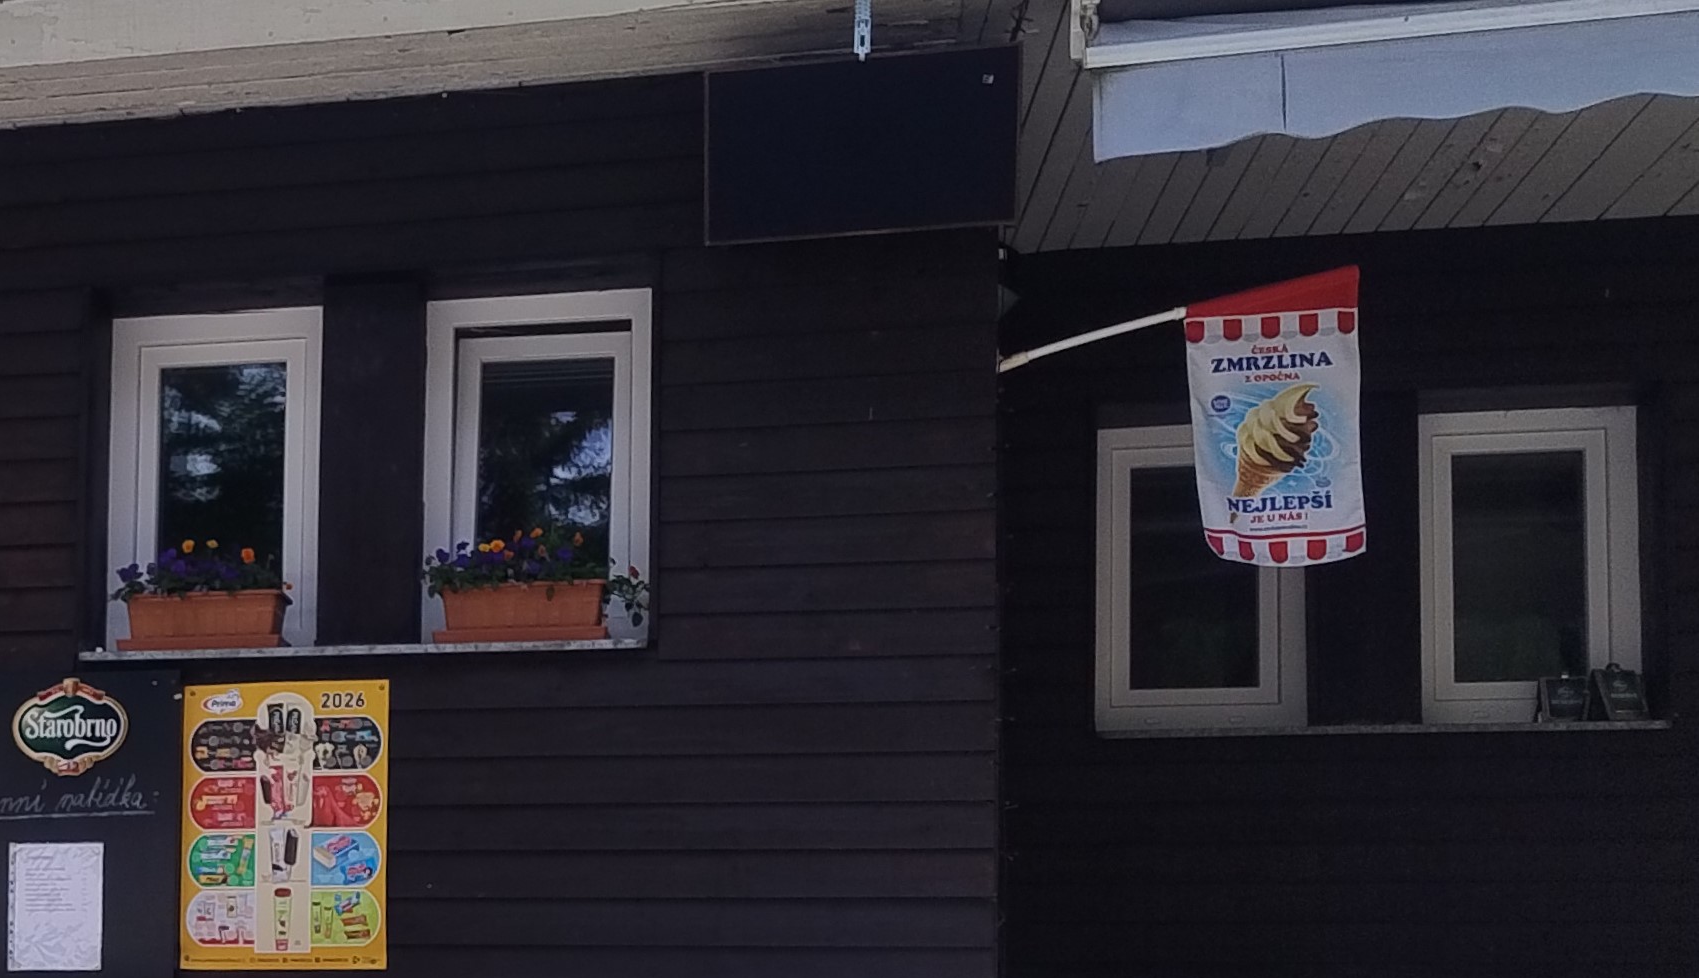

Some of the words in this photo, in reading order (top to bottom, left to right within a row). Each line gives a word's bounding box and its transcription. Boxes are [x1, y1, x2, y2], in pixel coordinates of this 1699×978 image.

[1251, 343, 1289, 355] ČESKÁ
[1210, 351, 1333, 373] ZMRZLINA
[1253, 371, 1301, 382] OPOČNA
[1226, 490, 1333, 514] NEJLEPŠÍ
[1250, 515, 1265, 524] JE
[1266, 514, 1276, 522] U
[1278, 512, 1303, 521] NÁS
[210, 698, 237, 708] Prima
[320, 692, 366, 709] 2026
[24, 704, 118, 750] Starobrno
